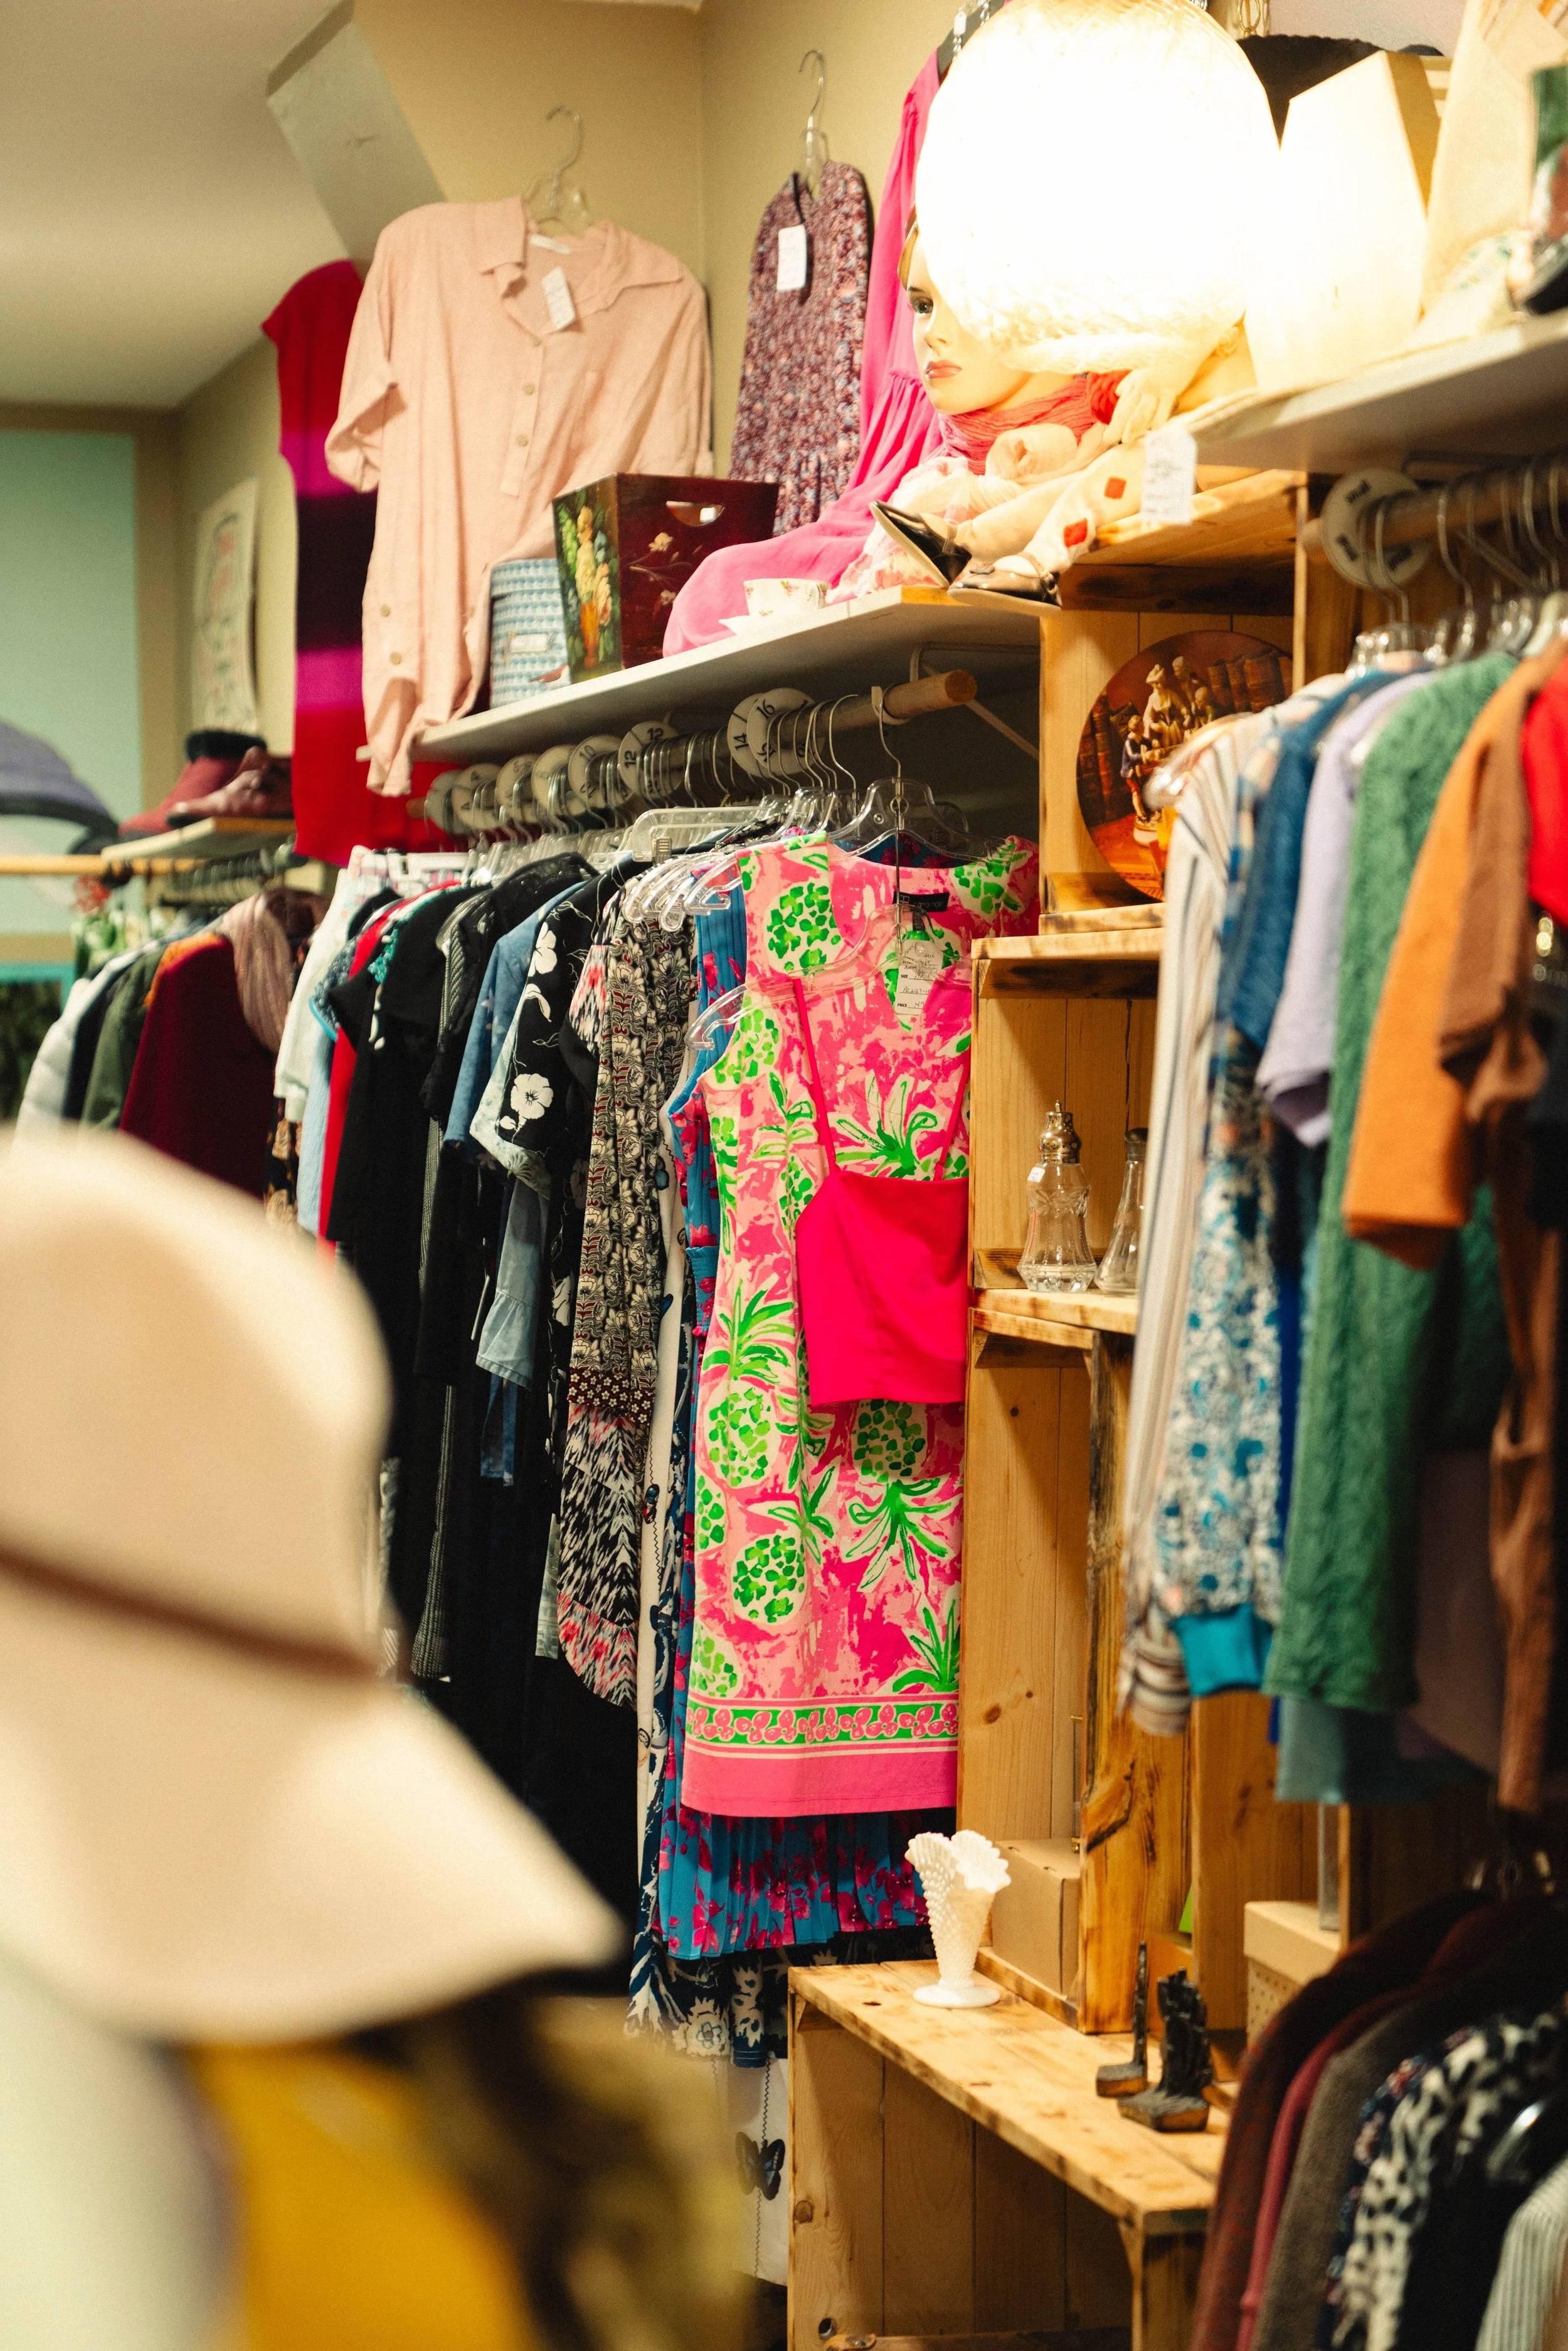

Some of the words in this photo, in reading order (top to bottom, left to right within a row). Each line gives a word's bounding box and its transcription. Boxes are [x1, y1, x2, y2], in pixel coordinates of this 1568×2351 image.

[756, 698, 775, 719] 16
[647, 727, 664, 741] 12
[733, 732, 750, 751] 14
[579, 745, 596, 762] 10
[624, 750, 637, 768] 12
